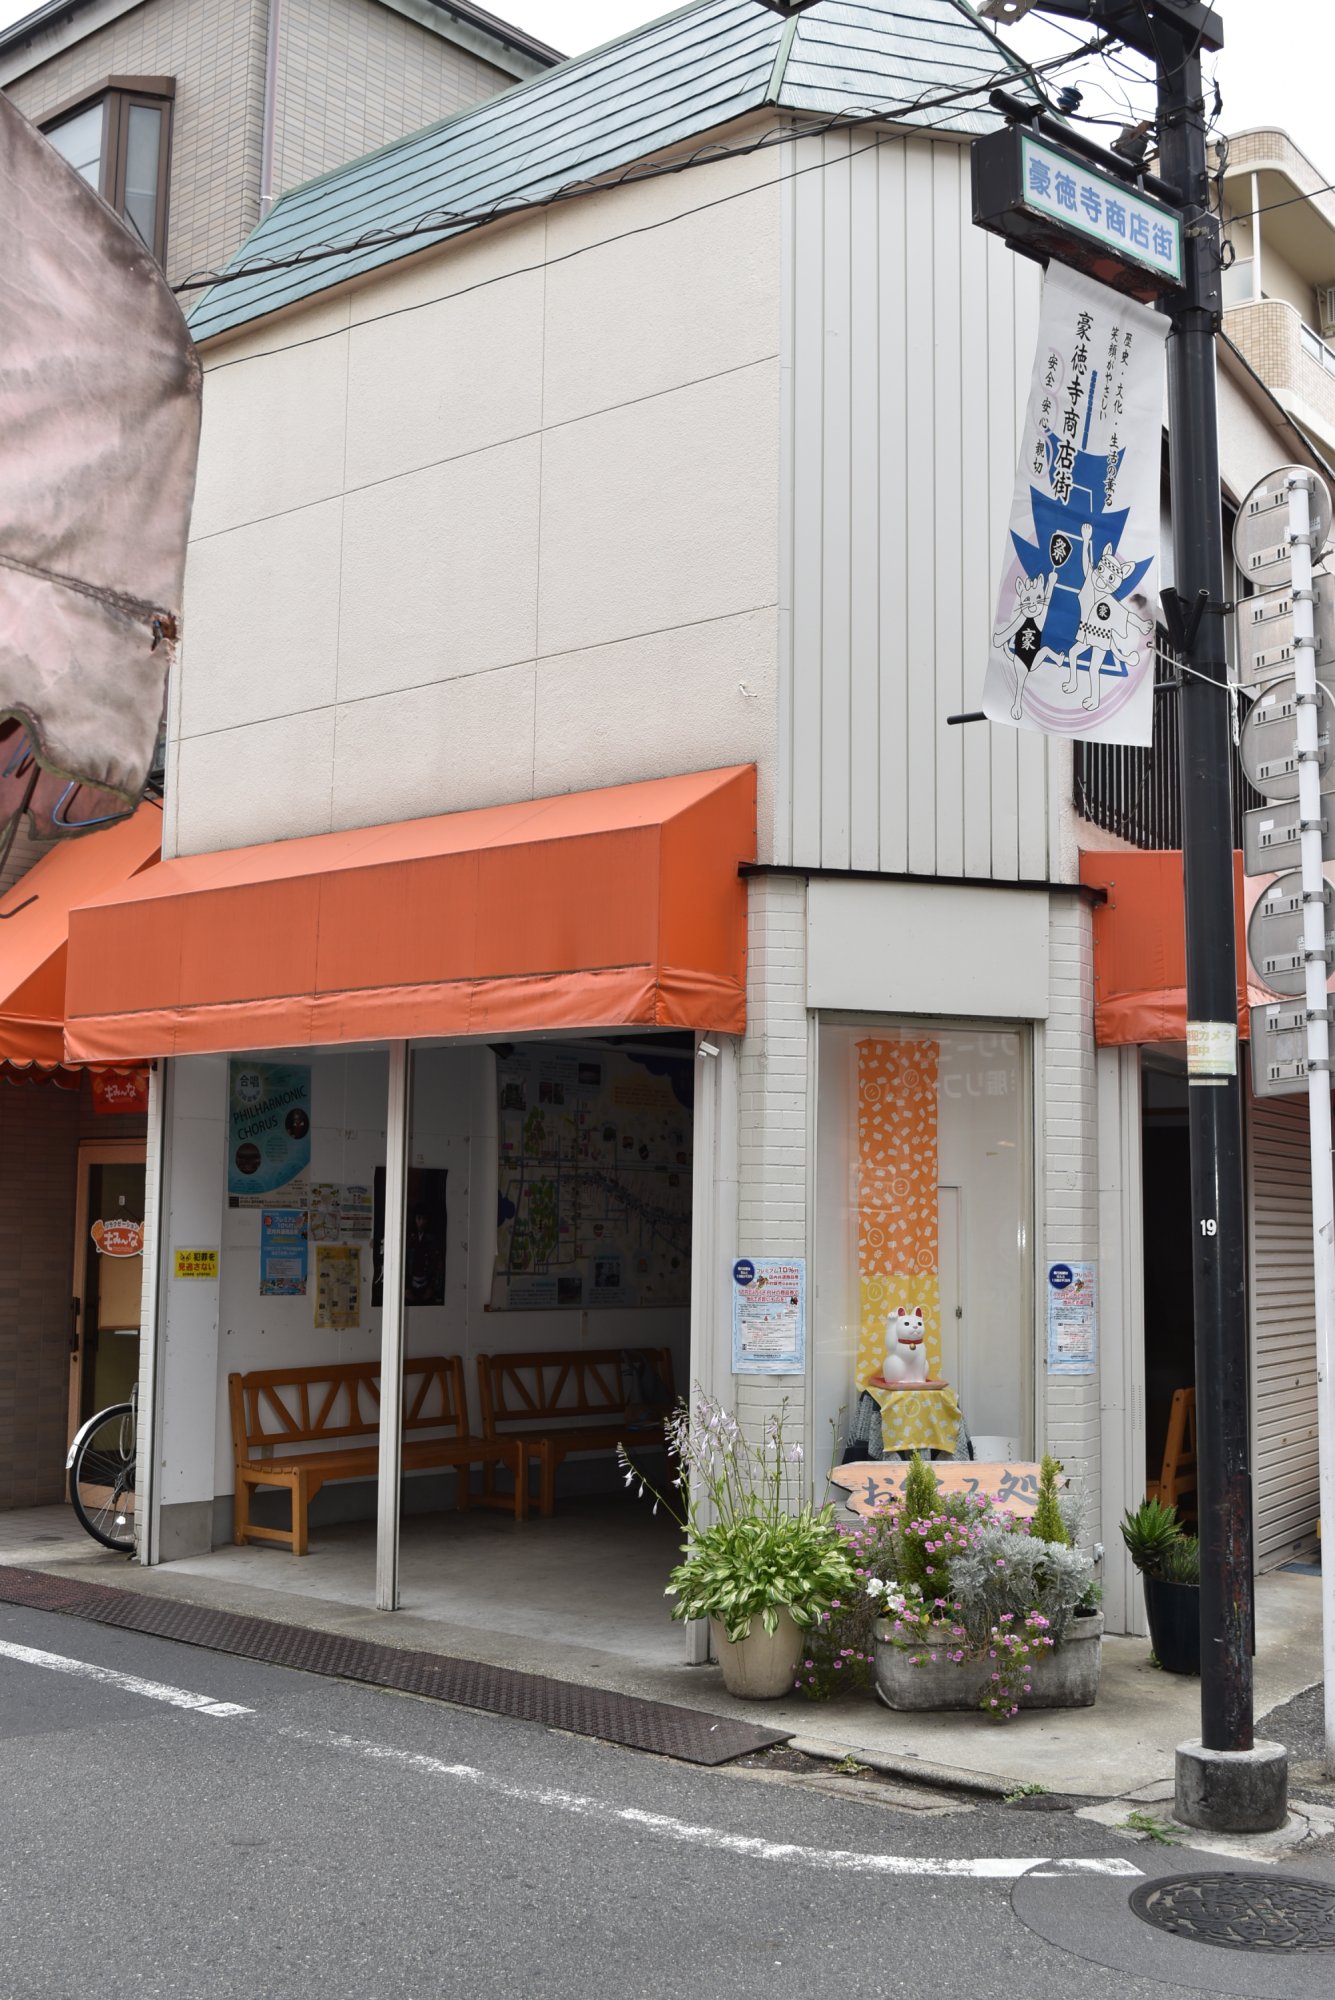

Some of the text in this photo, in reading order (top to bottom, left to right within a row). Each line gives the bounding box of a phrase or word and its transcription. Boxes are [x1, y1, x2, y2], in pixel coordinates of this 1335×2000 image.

[1028, 156, 1173, 262] 豪徳寺商店街
[1099, 326, 1120, 421] 笑顔がやさしい
[1032, 353, 1059, 475] 安全 安心 親切
[1052, 310, 1094, 504] 豪徳寺商店街
[1103, 331, 1133, 507] 歴史・文化・生活の薫る
[1051, 538, 1067, 563] 祭
[1098, 603, 1109, 619] 豪
[1020, 628, 1037, 651] 豪
[239, 1074, 260, 1088] 合唱
[233, 1085, 308, 1124] PHILHARMONIC
[237, 1114, 278, 1140] CHORUS
[104, 1219, 138, 1231] リラクゼーション
[1200, 1218, 1217, 1236] 19
[193, 1252, 215, 1261] 犯罪を
[862, 1469, 1040, 1507] お処
